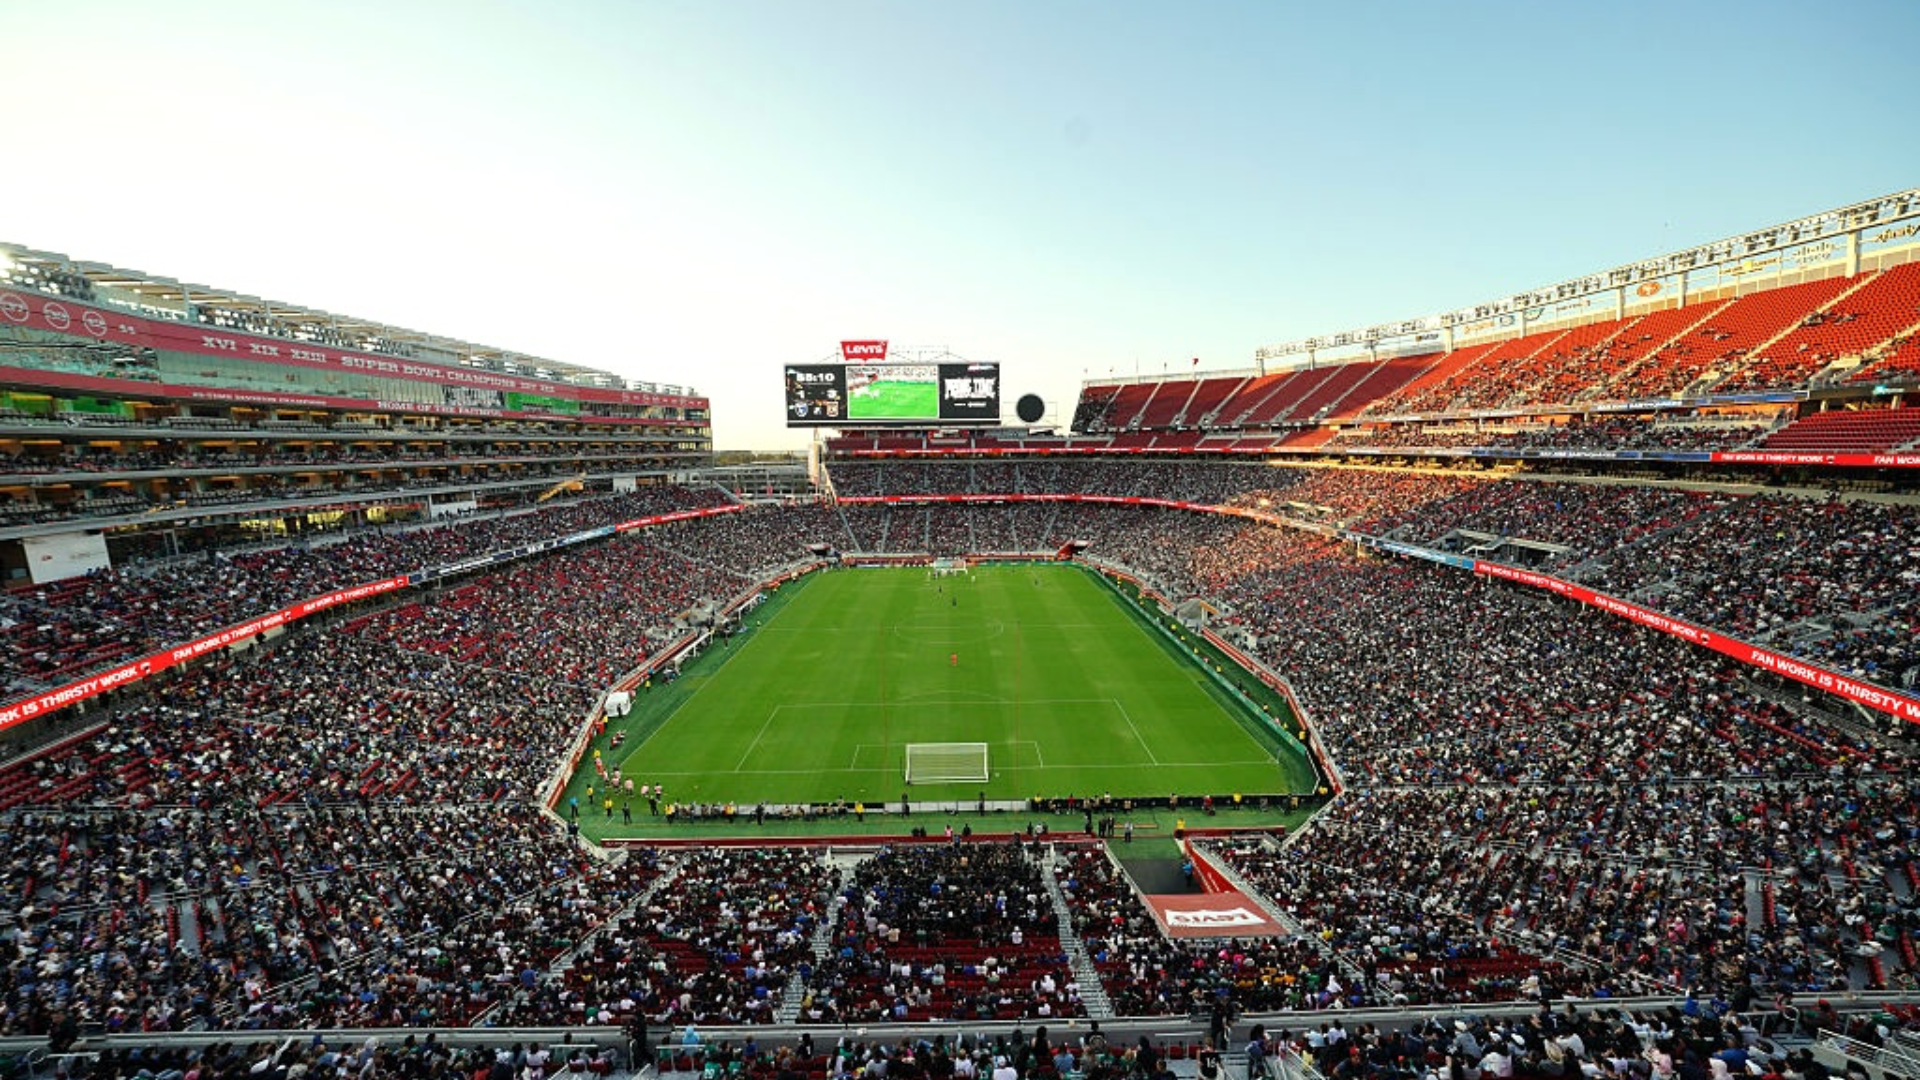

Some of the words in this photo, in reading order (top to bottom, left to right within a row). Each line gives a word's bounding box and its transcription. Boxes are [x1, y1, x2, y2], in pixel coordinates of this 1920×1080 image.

[202, 336, 237, 350] XVI
[250, 343, 279, 356] XIX
[341, 356, 398, 372] SUPER
[403, 364, 445, 379] BOWL
[447, 371, 516, 388] CHAMPIONS
[378, 401, 413, 411] HOME
[435, 405, 456, 413] THE
[1874, 455, 1894, 464] FAN
[343, 587, 374, 600] THIRSTY
[375, 580, 395, 592] WORK
[1521, 572, 1549, 586] THIRSTY
[172, 649, 192, 662] FAN
[193, 638, 221, 653] WORK
[230, 622, 262, 638] THIRSTY
[262, 614, 284, 628] WORK
[1595, 596, 1607, 606] FAN
[1608, 600, 1628, 615] WORK
[1629, 608, 1637, 617] IS
[1637, 611, 1669, 629] THIRSTY
[1671, 621, 1697, 639] WORK
[0, 707, 21, 725] RK
[22, 701, 39, 716] IS
[39, 680, 98, 708] THIRSTY
[99, 666, 137, 687] WORK
[1751, 650, 1774, 667] FAN
[1777, 658, 1816, 682] WORK
[1818, 671, 1833, 687] IS
[1835, 678, 1903, 711] THIRSTY
